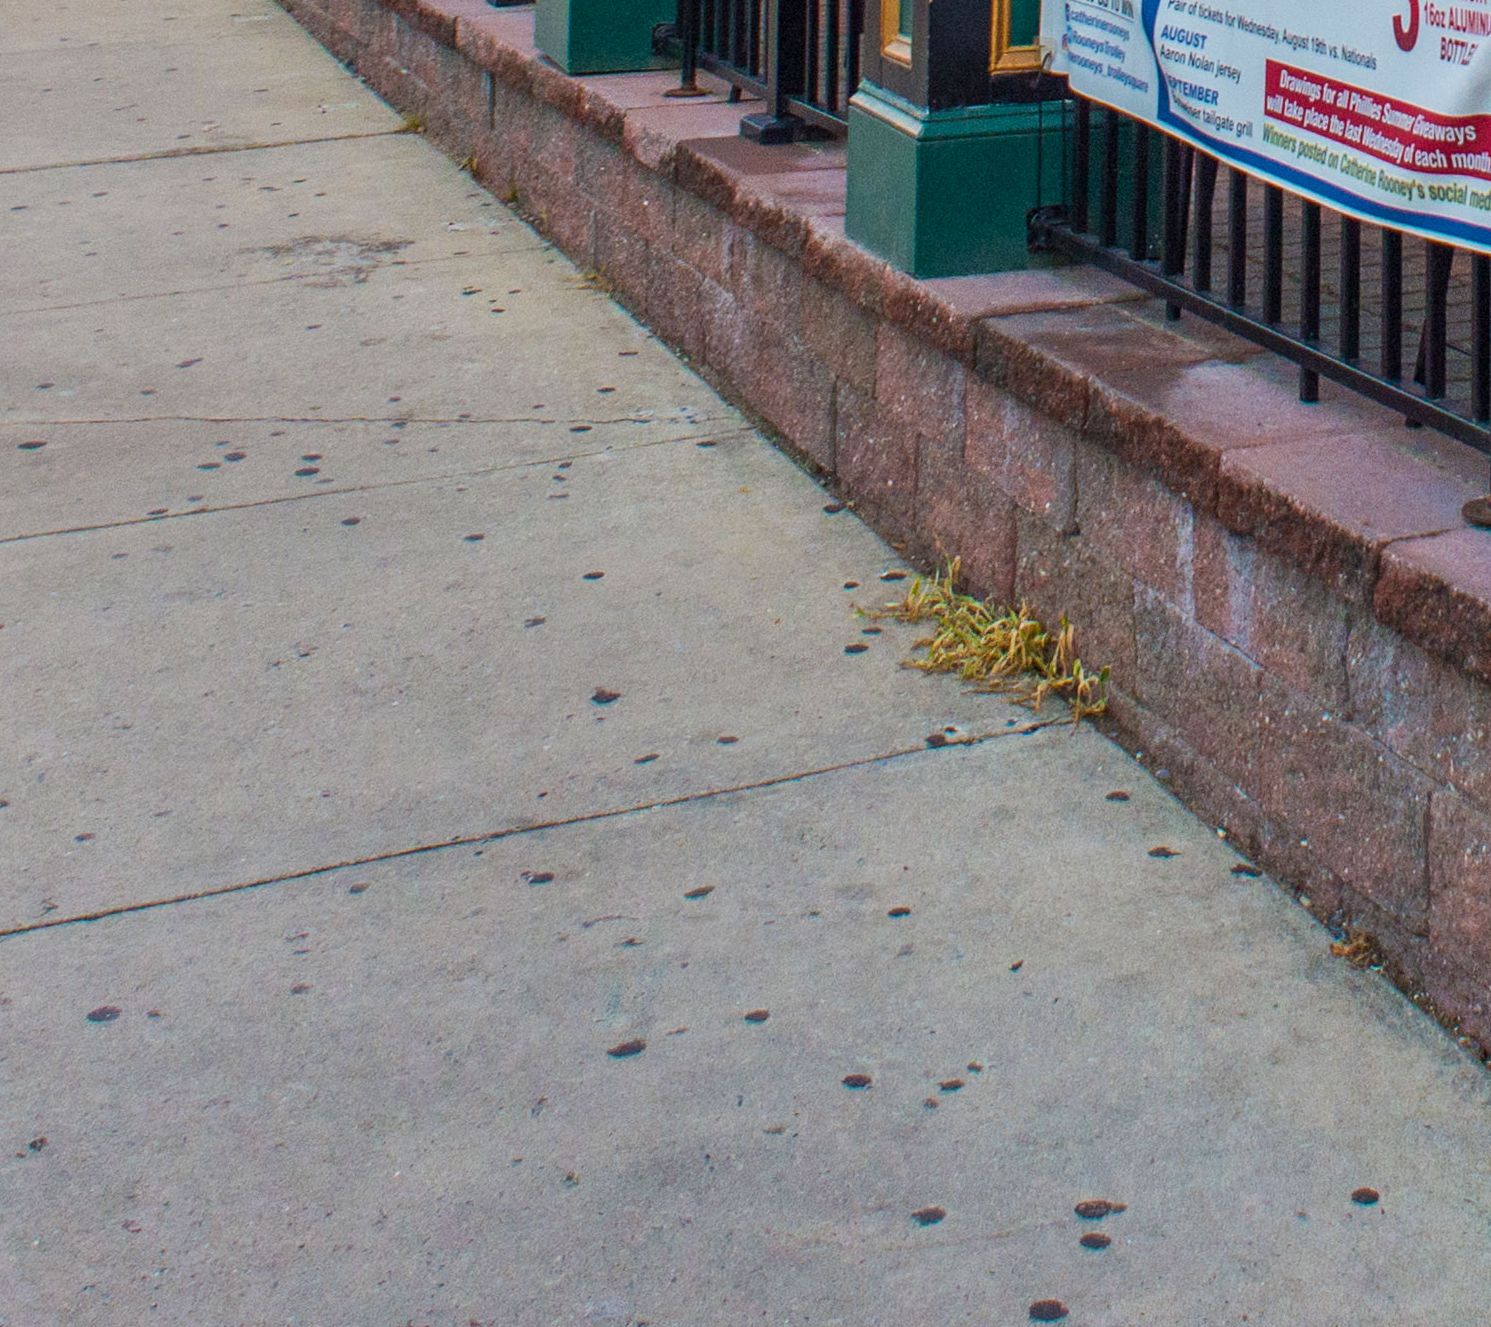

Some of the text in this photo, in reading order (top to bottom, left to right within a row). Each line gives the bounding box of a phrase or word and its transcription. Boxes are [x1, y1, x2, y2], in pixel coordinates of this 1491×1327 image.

[1161, 24, 1207, 49] AUGUST
[1199, 1, 1224, 27] tickets
[1225, 6, 1235, 27] for
[1236, 11, 1281, 45] Wednesday,
[1281, 28, 1309, 51] August
[1341, 45, 1377, 71] Nationals
[1424, 1, 1445, 28] 16oz
[1160, 43, 1242, 84] Aaron Nolan jersey
[1203, 108, 1253, 137] tailgate grill
[1267, 95, 1283, 114] will
[1284, 99, 1303, 121] take
[1304, 108, 1329, 131] place
[1330, 115, 1344, 136] the
[1345, 119, 1362, 143] last
[1404, 144, 1414, 163] of
[1415, 149, 1447, 168] each
[1280, 69, 1476, 144] Drawings for all Phillies Giveaways
[1263, 123, 1296, 153] Winners
[1297, 141, 1328, 164] posted
[1328, 152, 1339, 169] on
[1340, 153, 1376, 186] Catherine
[1378, 170, 1425, 201] Rooney's
[1428, 182, 1468, 205] social
